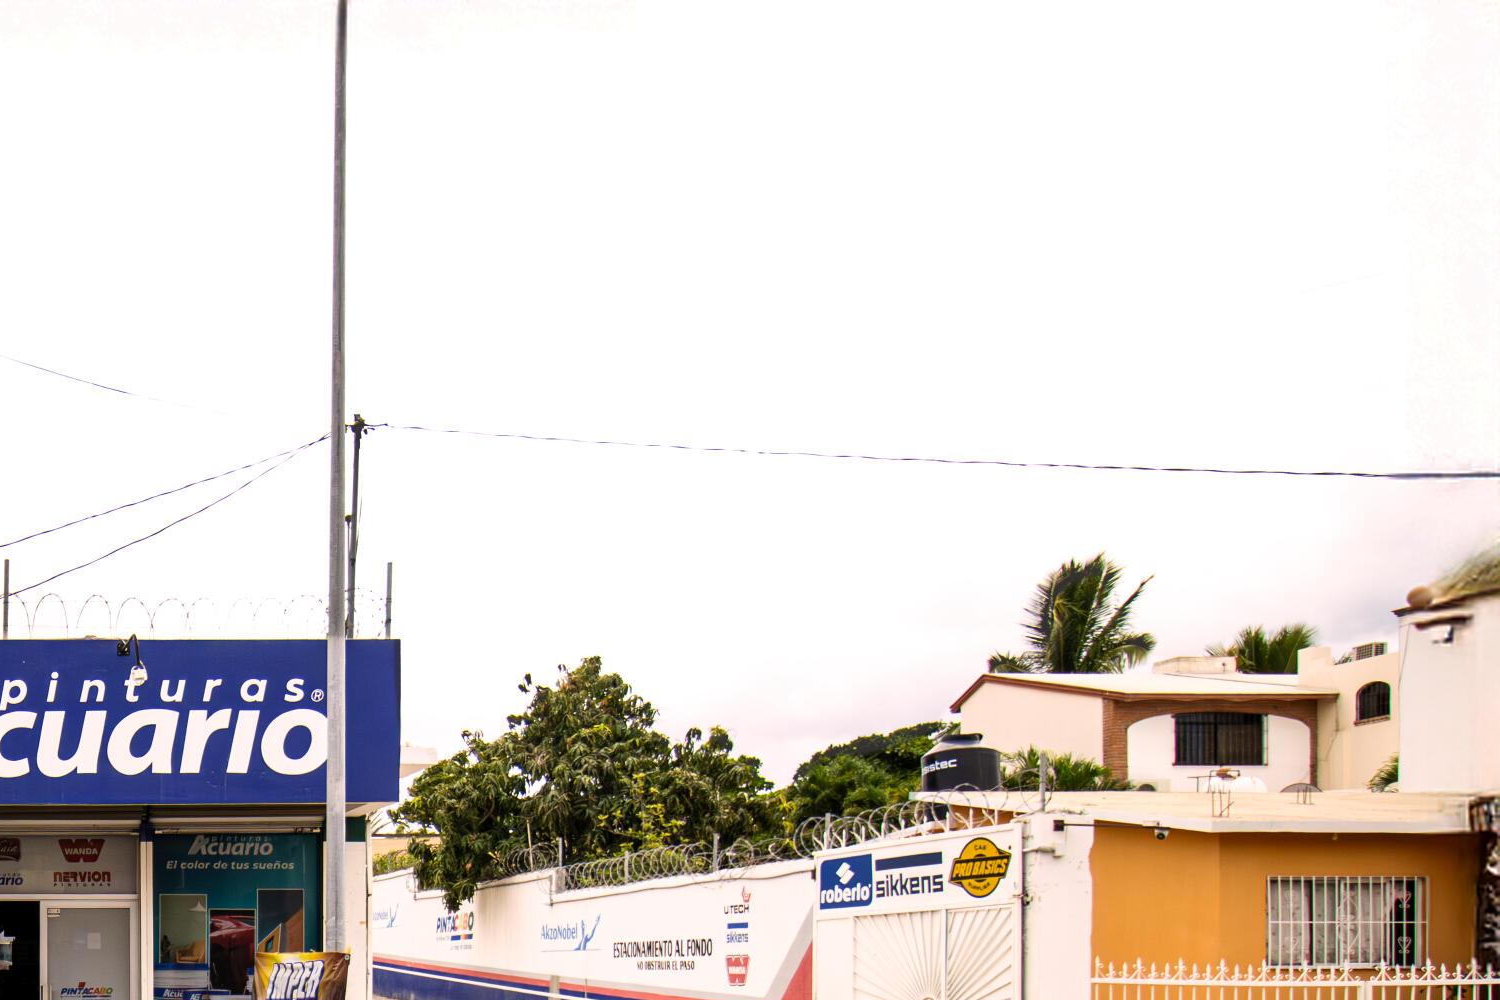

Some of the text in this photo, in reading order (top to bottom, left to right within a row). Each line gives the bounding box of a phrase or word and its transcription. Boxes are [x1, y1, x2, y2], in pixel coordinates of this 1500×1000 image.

[0, 671, 305, 711] pinturas
[64, 847, 99, 855] WANDA
[188, 835, 274, 856] Acuario
[166, 859, 295, 870] El color de tus sueños
[820, 883, 869, 904] roberlo
[876, 874, 944, 899] sikkens
[541, 922, 578, 941] AkzoNobel
[613, 938, 713, 959] ESTACIONAMIENTO AL FONDO
